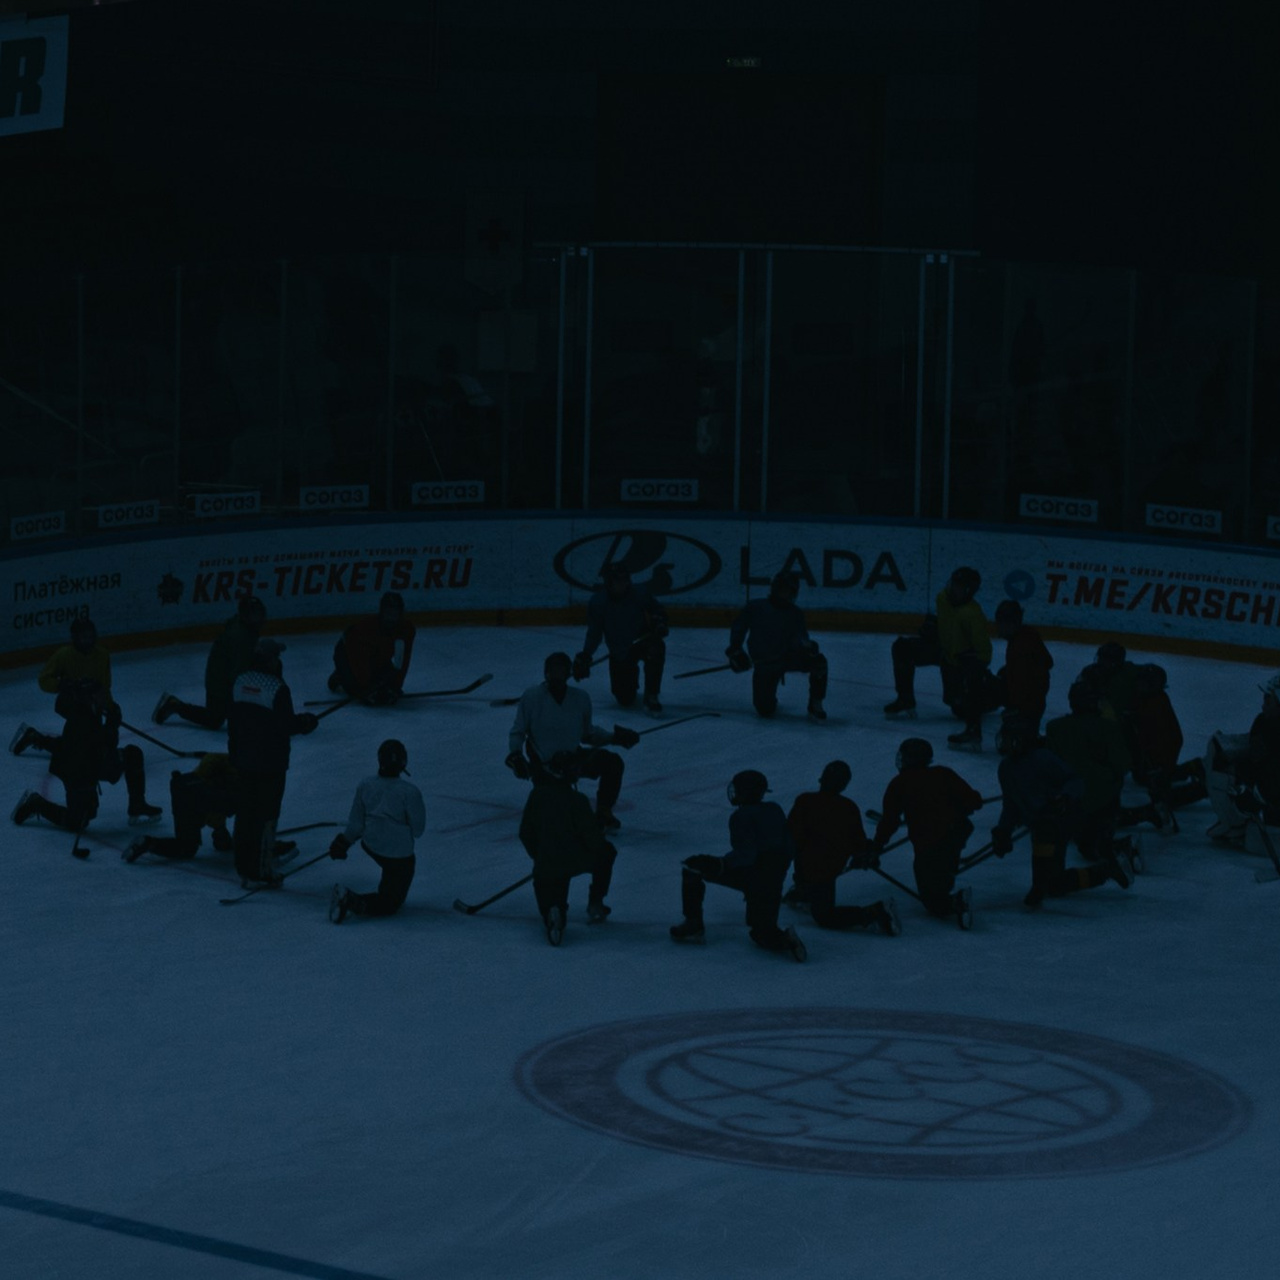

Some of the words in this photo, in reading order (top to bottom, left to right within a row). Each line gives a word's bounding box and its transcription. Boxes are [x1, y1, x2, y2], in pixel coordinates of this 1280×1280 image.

[13, 572, 122, 602] Платёжная
[192, 558, 474, 605] KRS-TICKETS.RU
[739, 546, 907, 592] LADA
[13, 603, 90, 630] система
